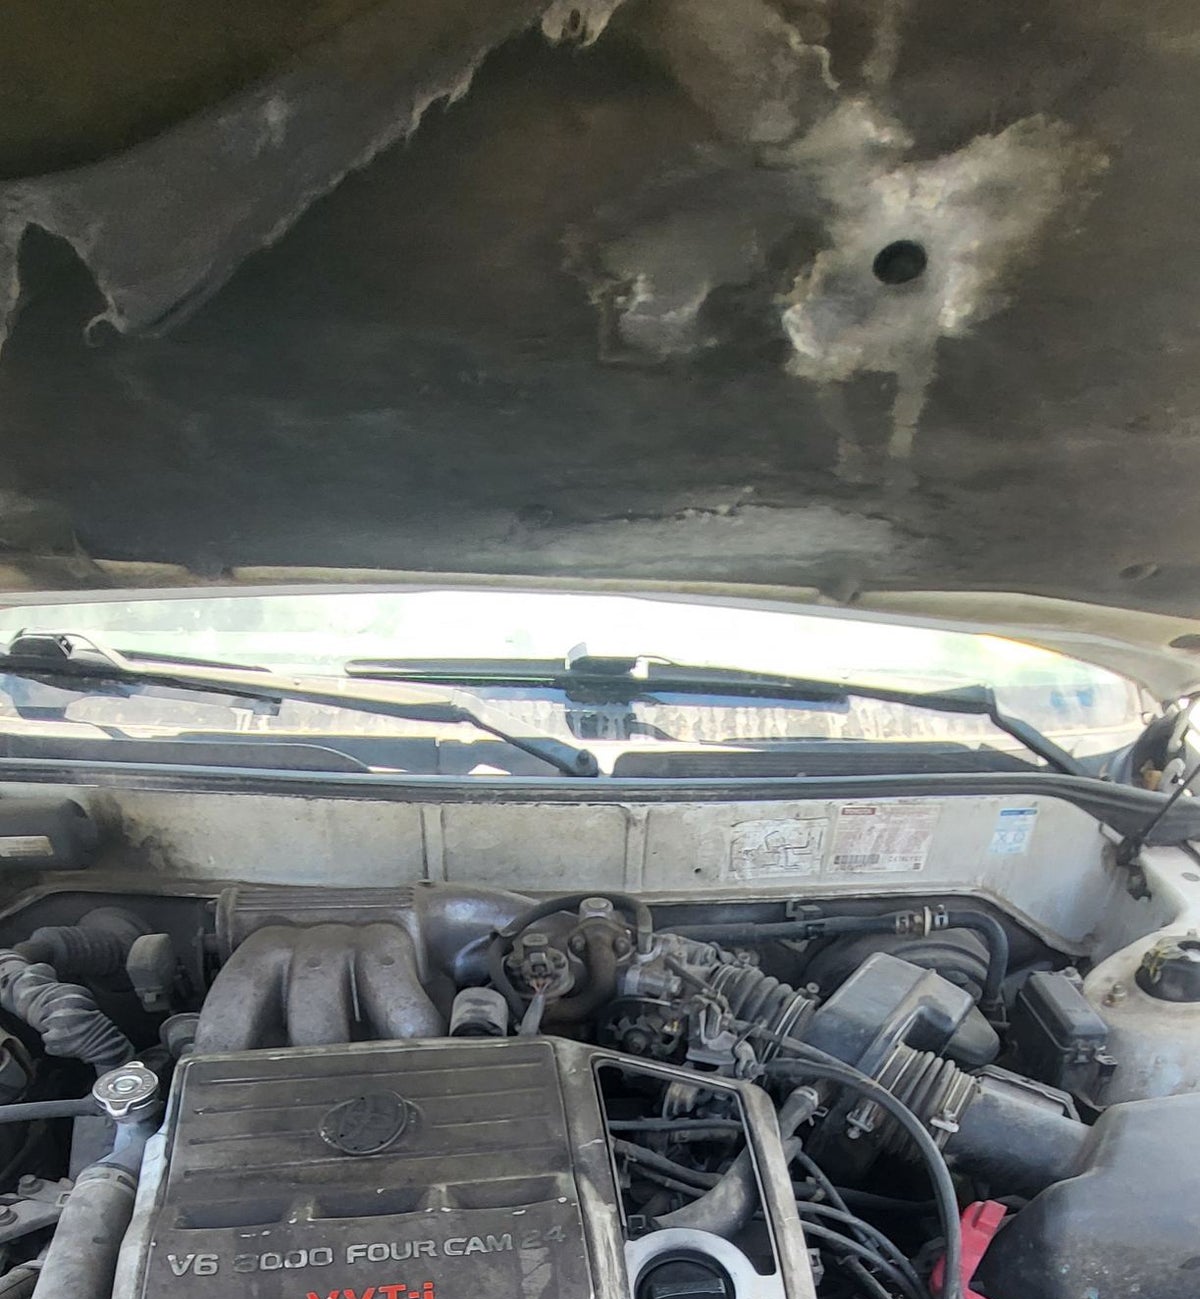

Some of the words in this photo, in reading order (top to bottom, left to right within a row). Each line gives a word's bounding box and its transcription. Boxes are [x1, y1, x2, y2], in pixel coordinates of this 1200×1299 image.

[167, 1252, 220, 1277] V6
[233, 1246, 334, 1273] 3000
[346, 1239, 438, 1265] FOUR
[443, 1232, 514, 1257] CAM
[520, 1224, 567, 1249] 24
